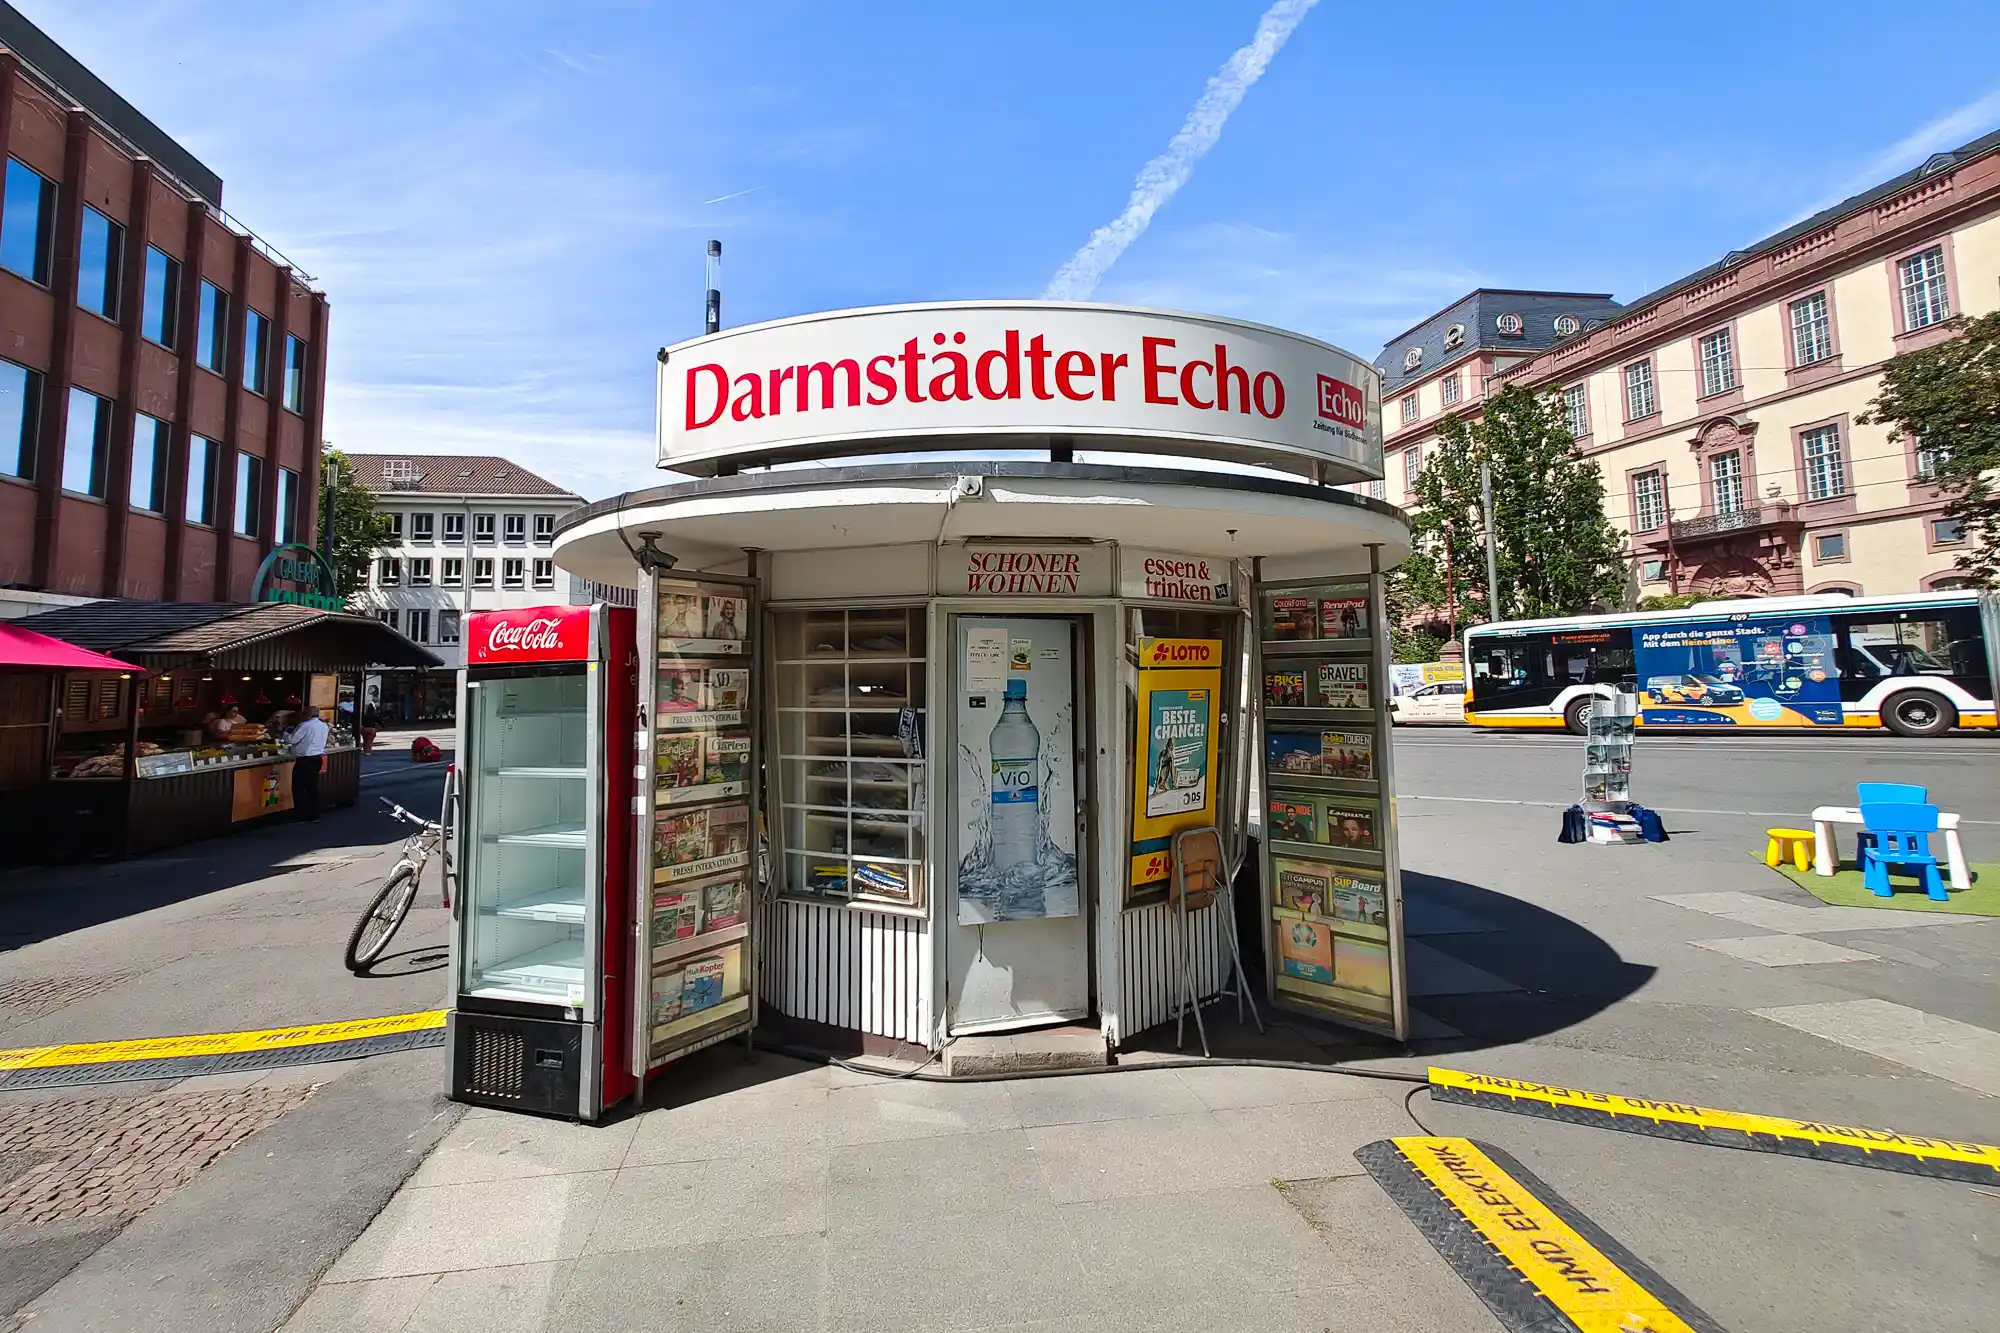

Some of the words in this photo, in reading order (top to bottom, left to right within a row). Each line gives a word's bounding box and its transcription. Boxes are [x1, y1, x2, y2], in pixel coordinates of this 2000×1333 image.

[684, 330, 1128, 431] Darmstädter
[1142, 336, 1286, 420] Echo
[1321, 380, 1362, 424] Echo
[1312, 420, 1336, 436] Zeitung
[280, 558, 320, 587] GALERIA
[967, 573, 1080, 594] WOHNEN
[1144, 579, 1212, 601] trinken
[488, 618, 563, 651] Coca-Cola
[1642, 633, 1660, 641] App
[1662, 631, 1687, 639] durch
[1689, 629, 1704, 638] die
[1706, 629, 1734, 638] ganze
[1736, 626, 1765, 635] Stadt.
[1643, 640, 1658, 648] Mit
[1660, 639, 1681, 648] dem
[1171, 645, 1210, 661] LOTTO
[1320, 666, 1361, 680] GRAVEL
[1162, 709, 1196, 725] BESTE
[1154, 723, 1205, 740] CHANCE!
[1328, 809, 1372, 820] Esquire
[673, 864, 694, 877] PRESSE
[695, 855, 739, 873] INTERNATIONAL
[1464, 1073, 1610, 1104] ELEKTRIK
[1624, 1098, 1702, 1117] HMD
[1792, 1120, 1985, 1155] ELEKTRIK
[1425, 1144, 1541, 1232] ELEKTRIK
[1530, 1240, 1610, 1295] HMD
